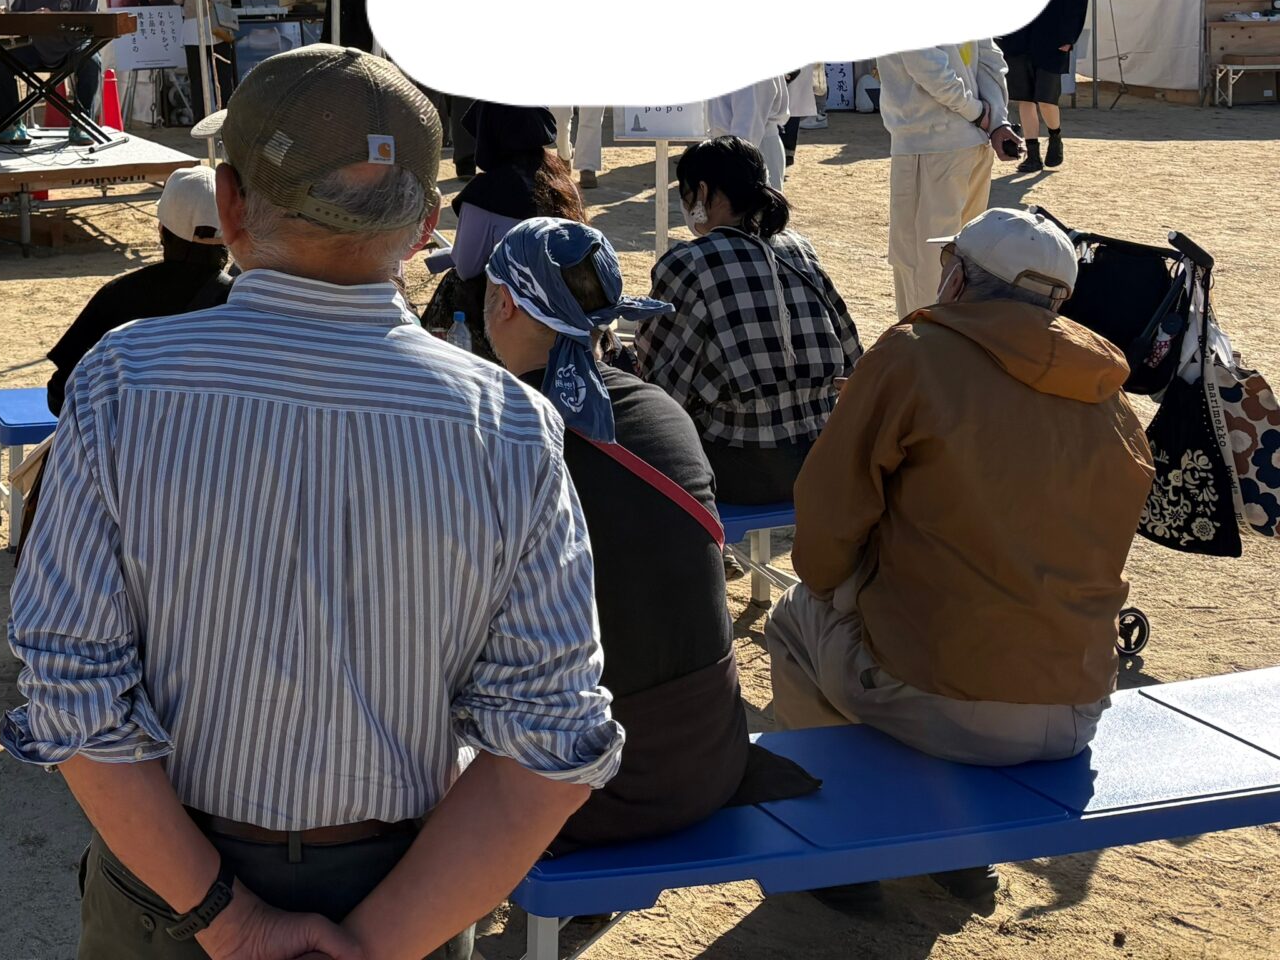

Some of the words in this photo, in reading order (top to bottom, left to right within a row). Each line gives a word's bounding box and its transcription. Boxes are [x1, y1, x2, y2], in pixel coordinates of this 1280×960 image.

[148, 11, 157, 36] 上品な
[157, 11, 169, 52] なめらかで
[167, 11, 177, 43] しっとり
[1207, 382, 1227, 448] marimekko
